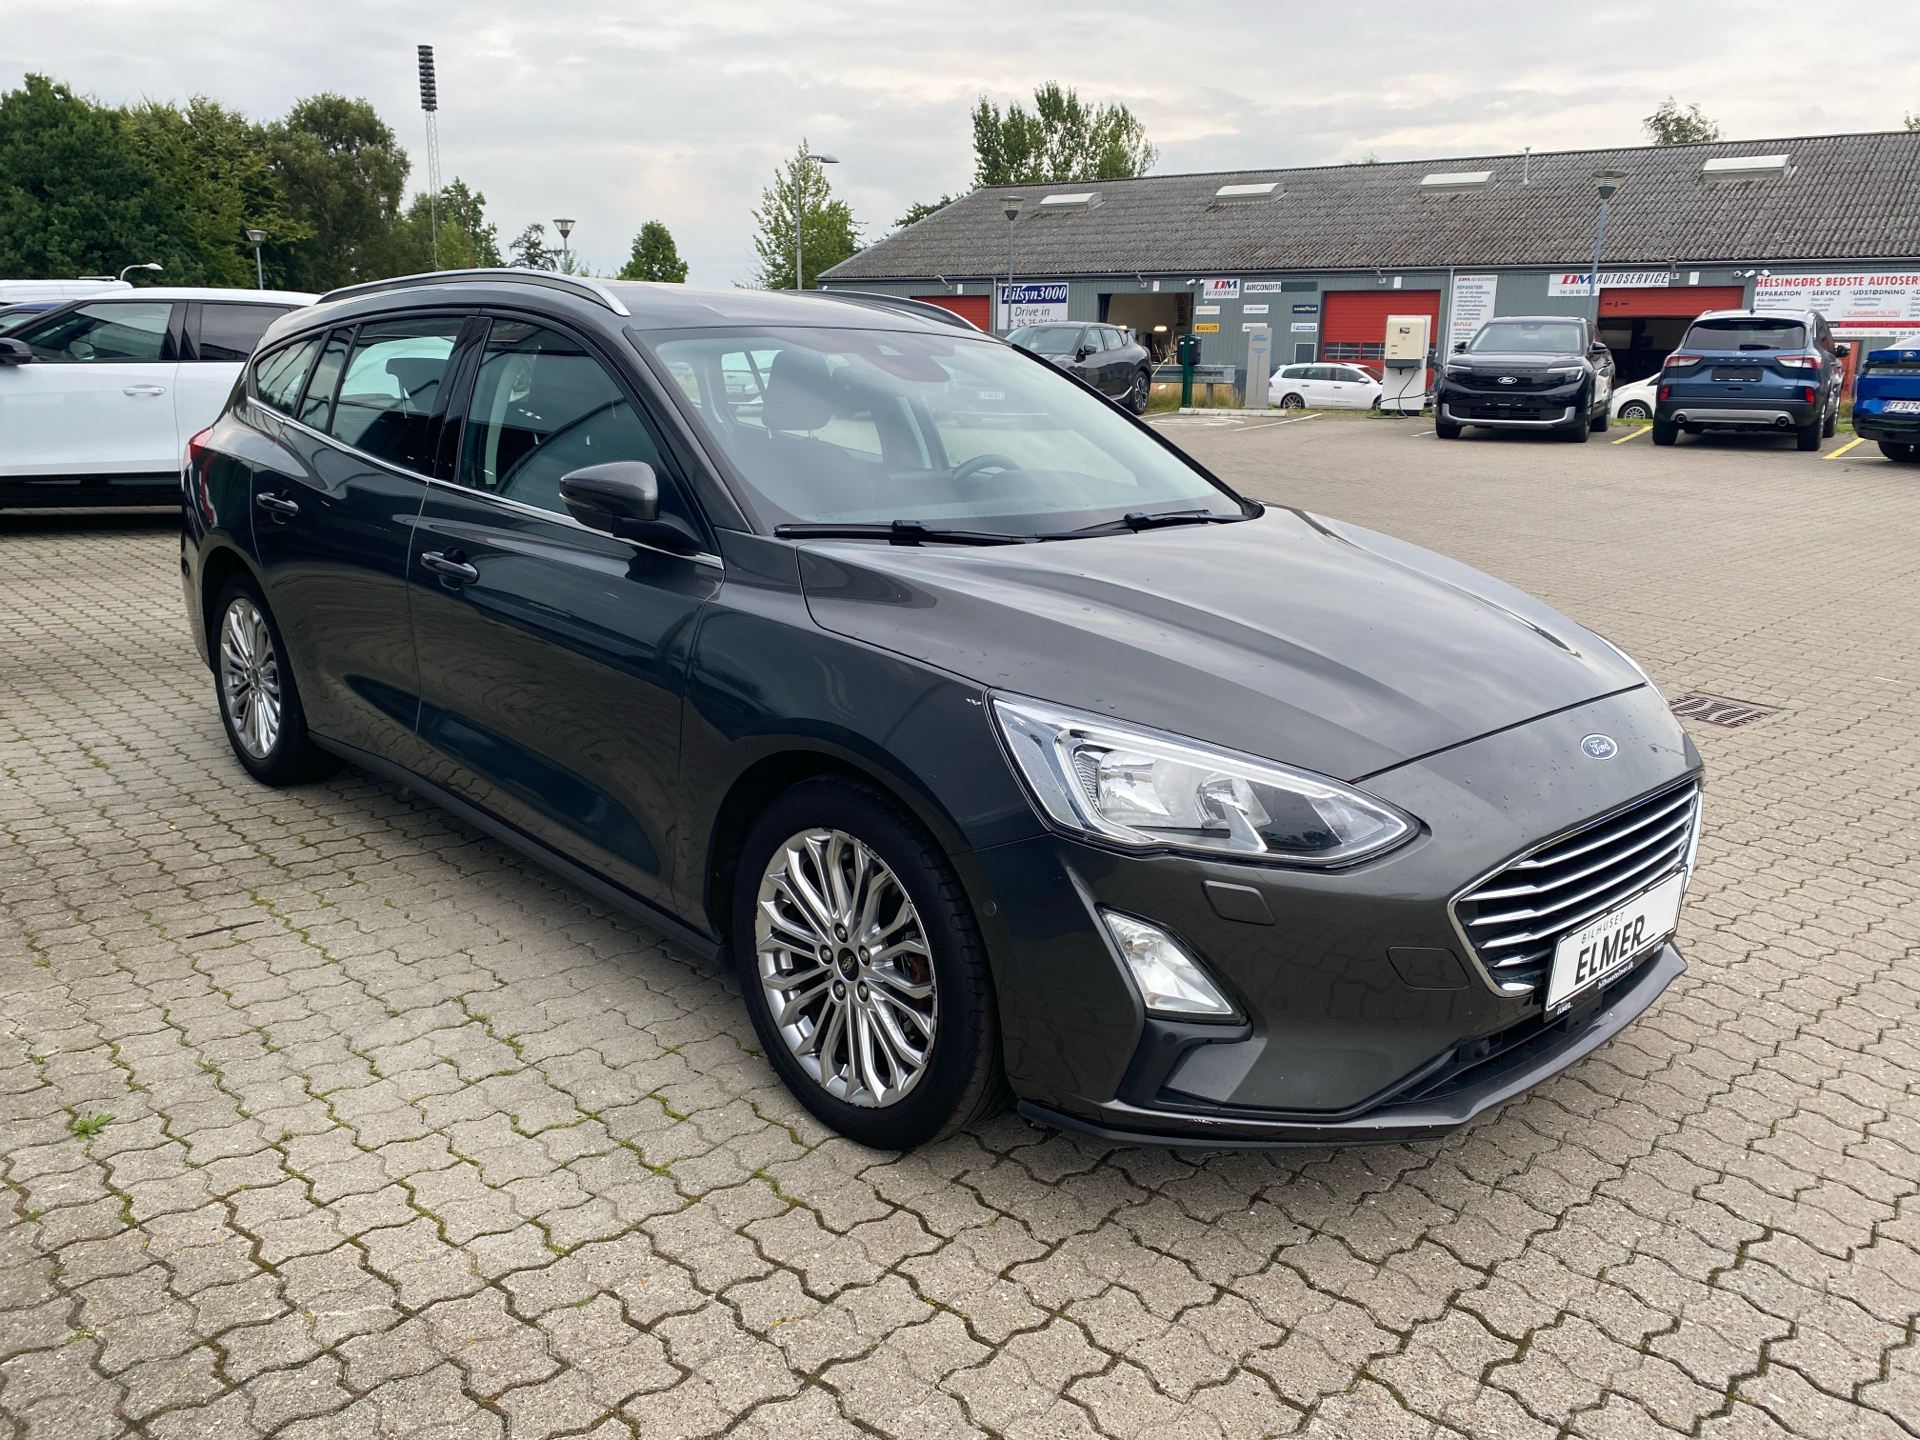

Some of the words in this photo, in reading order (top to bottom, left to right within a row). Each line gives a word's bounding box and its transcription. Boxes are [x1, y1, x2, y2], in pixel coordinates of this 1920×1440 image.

[1213, 280, 1238, 290] DM
[1562, 274, 1592, 285] DM
[1596, 272, 1669, 284] AUTOSERVICE
[1755, 277, 1822, 288] HELSINGØRS
[1825, 276, 1865, 287] BEDSTE
[1868, 275, 1920, 286] AUTOSER
[1205, 289, 1239, 297] AUTOSERVICE
[1015, 306, 1039, 317] Drive
[1041, 305, 1051, 316] in
[1588, 739, 1611, 755] Ford
[1581, 911, 1625, 945] BILHUSET
